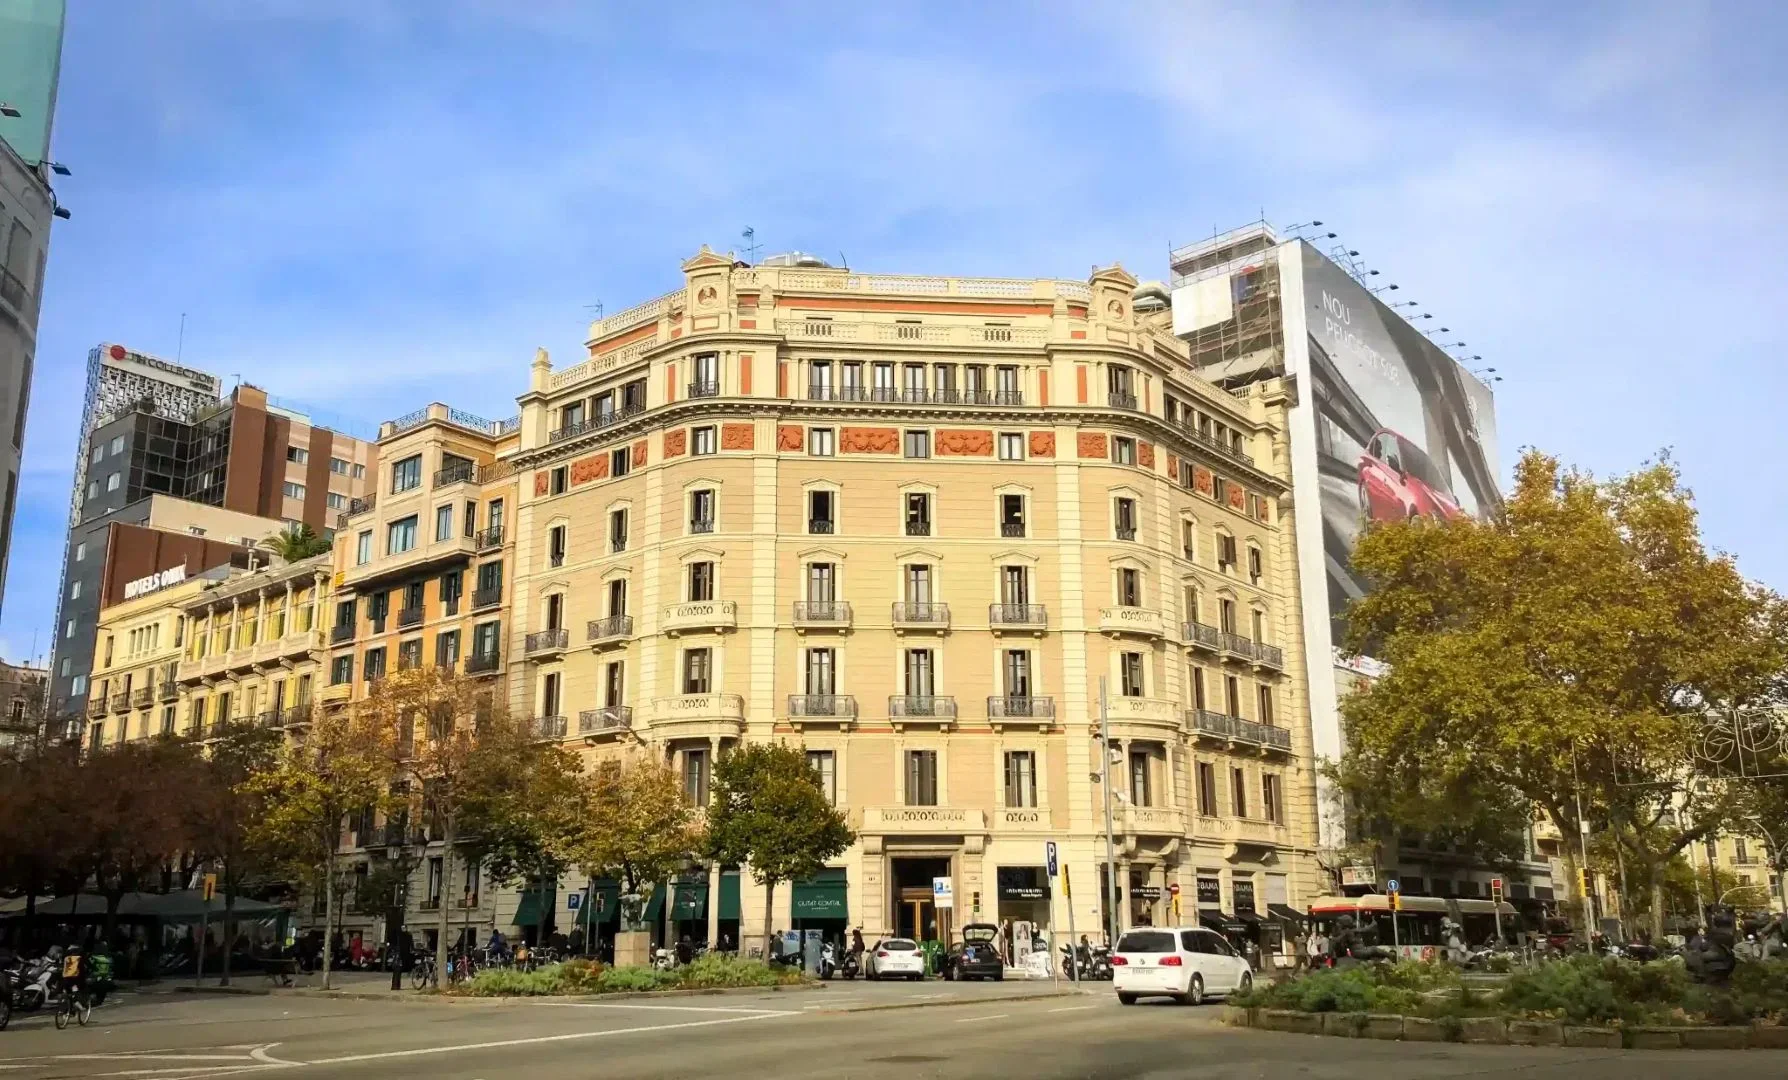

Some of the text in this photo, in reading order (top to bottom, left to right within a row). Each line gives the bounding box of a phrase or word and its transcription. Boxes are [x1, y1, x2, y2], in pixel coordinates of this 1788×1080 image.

[1322, 289, 1350, 325] NOU
[148, 358, 215, 385] COLLECTION
[125, 573, 160, 598] HOTELS
[1048, 843, 1056, 863] P
[570, 896, 577, 907] P
